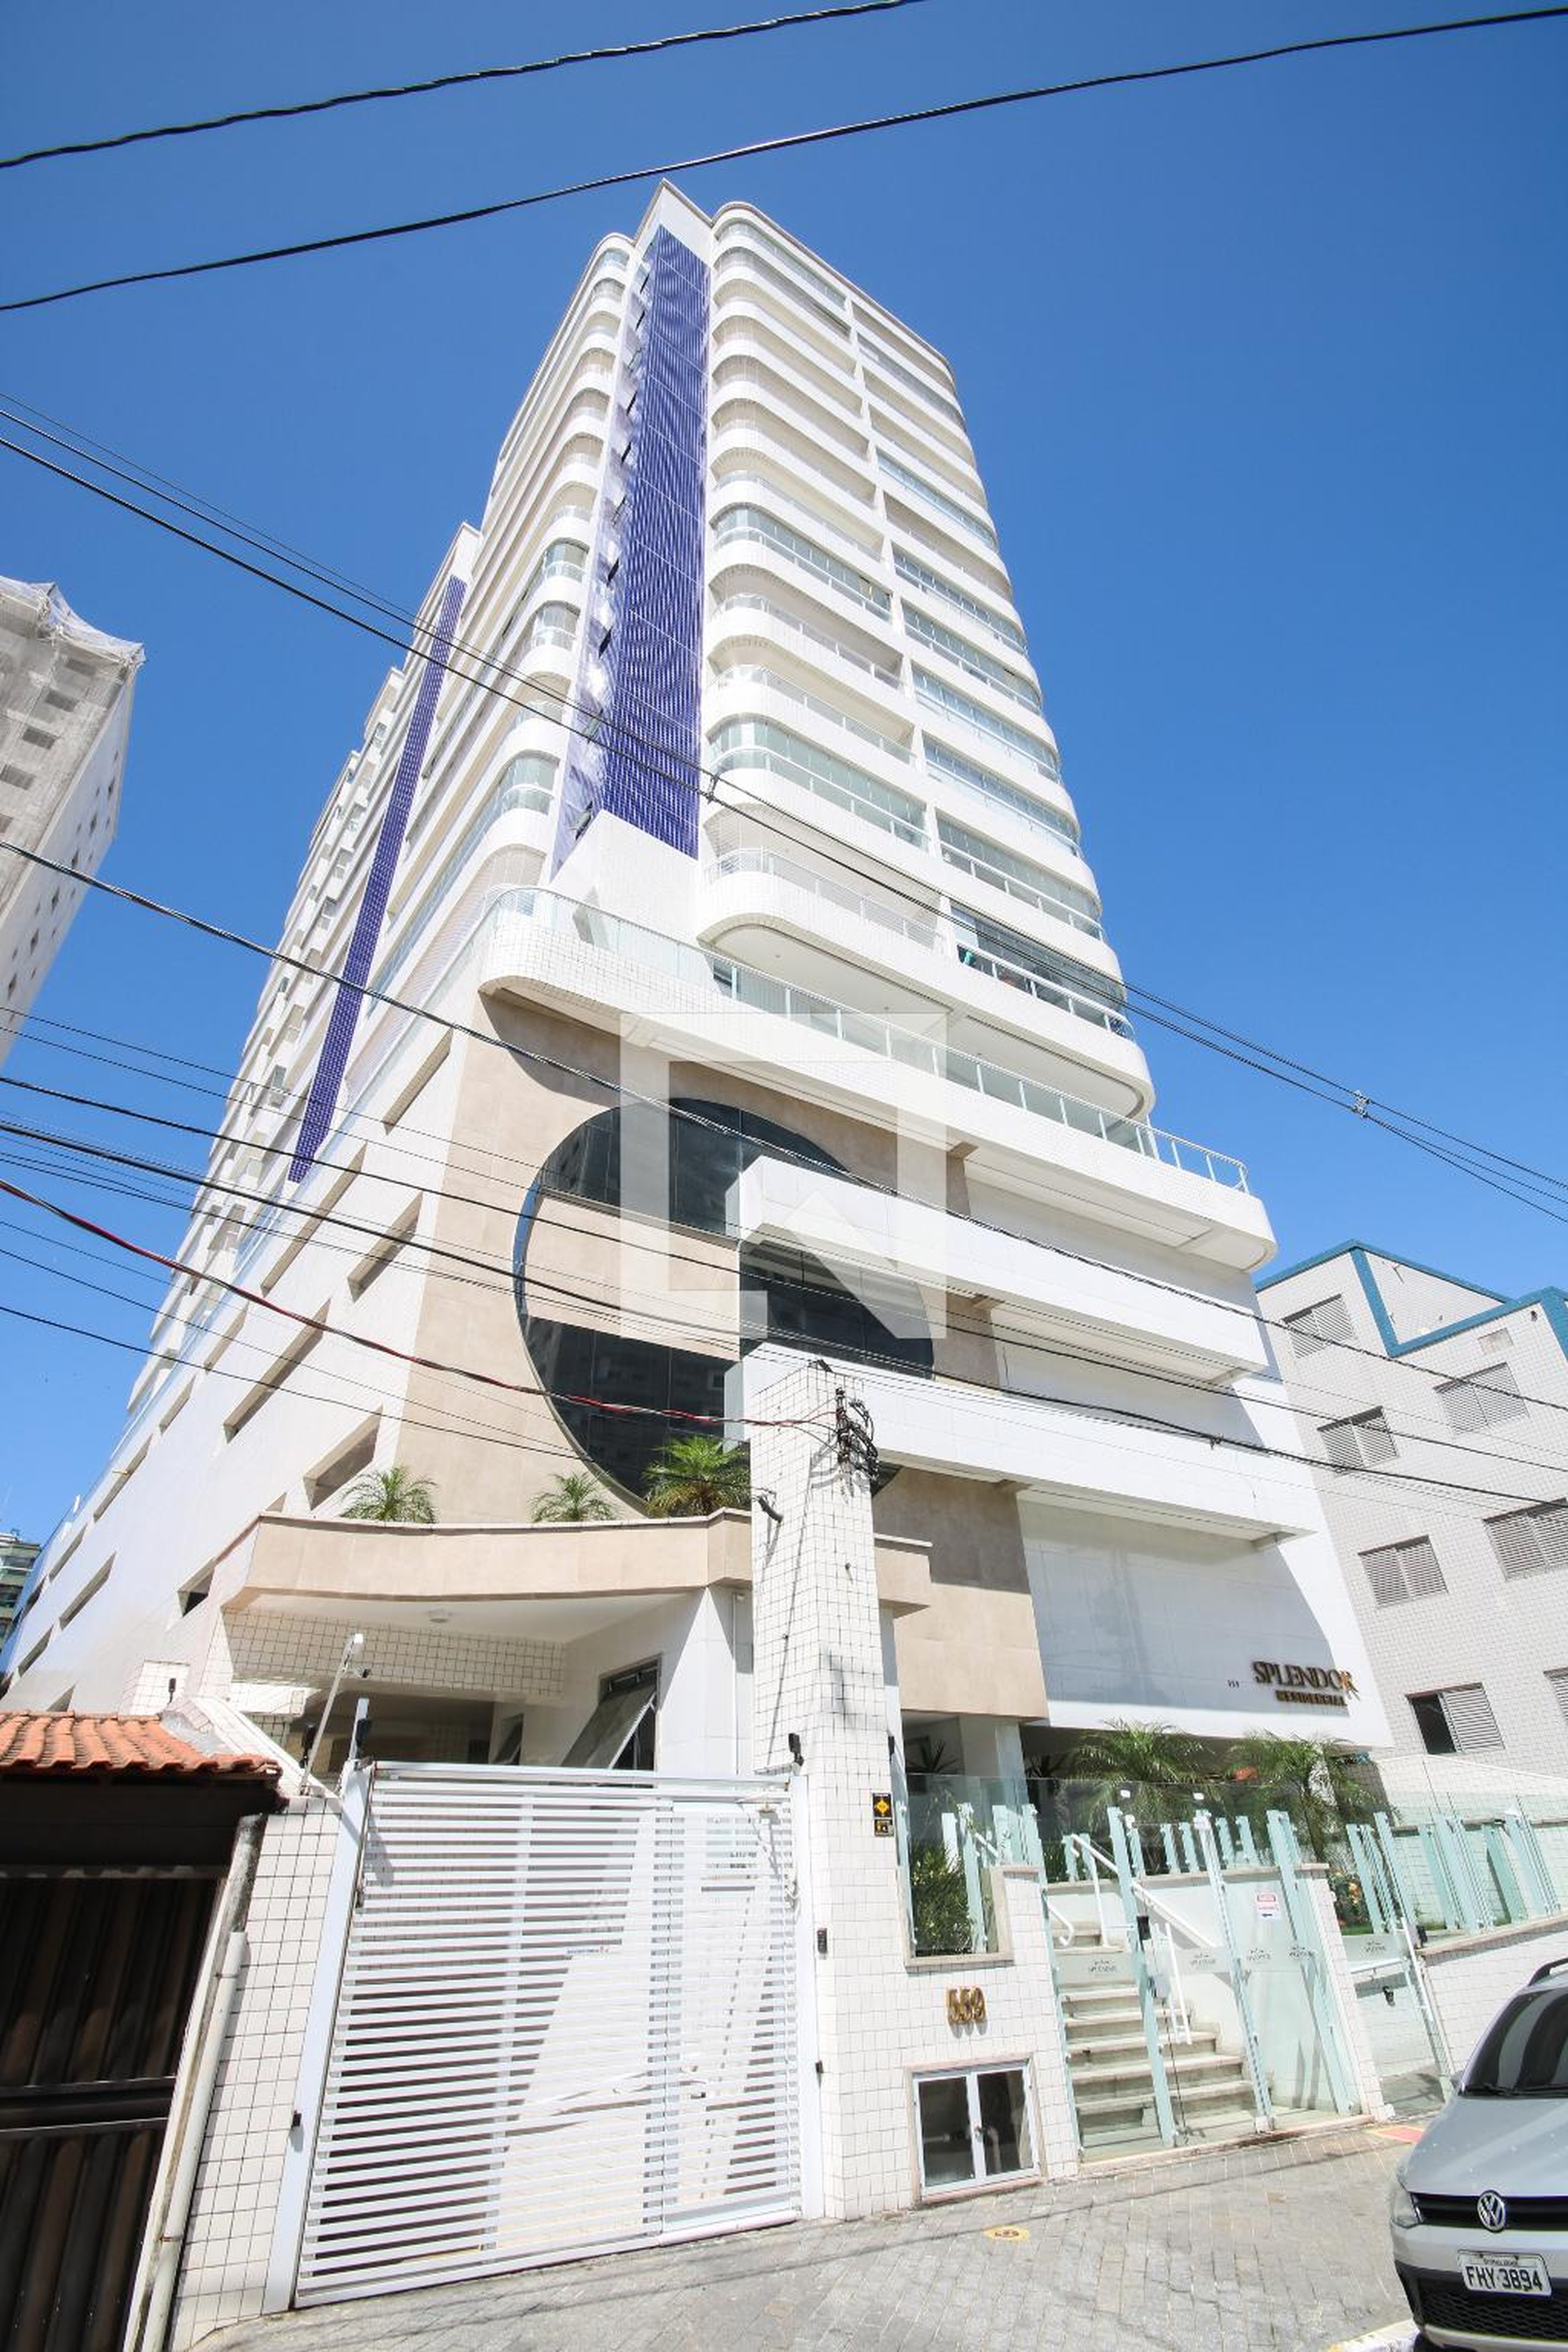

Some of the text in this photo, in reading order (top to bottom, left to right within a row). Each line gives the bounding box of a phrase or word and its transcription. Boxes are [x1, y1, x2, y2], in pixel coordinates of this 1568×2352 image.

[1252, 1661, 1359, 1693] SPLENDOR
[1466, 2266, 1543, 2292] FHY 3894
